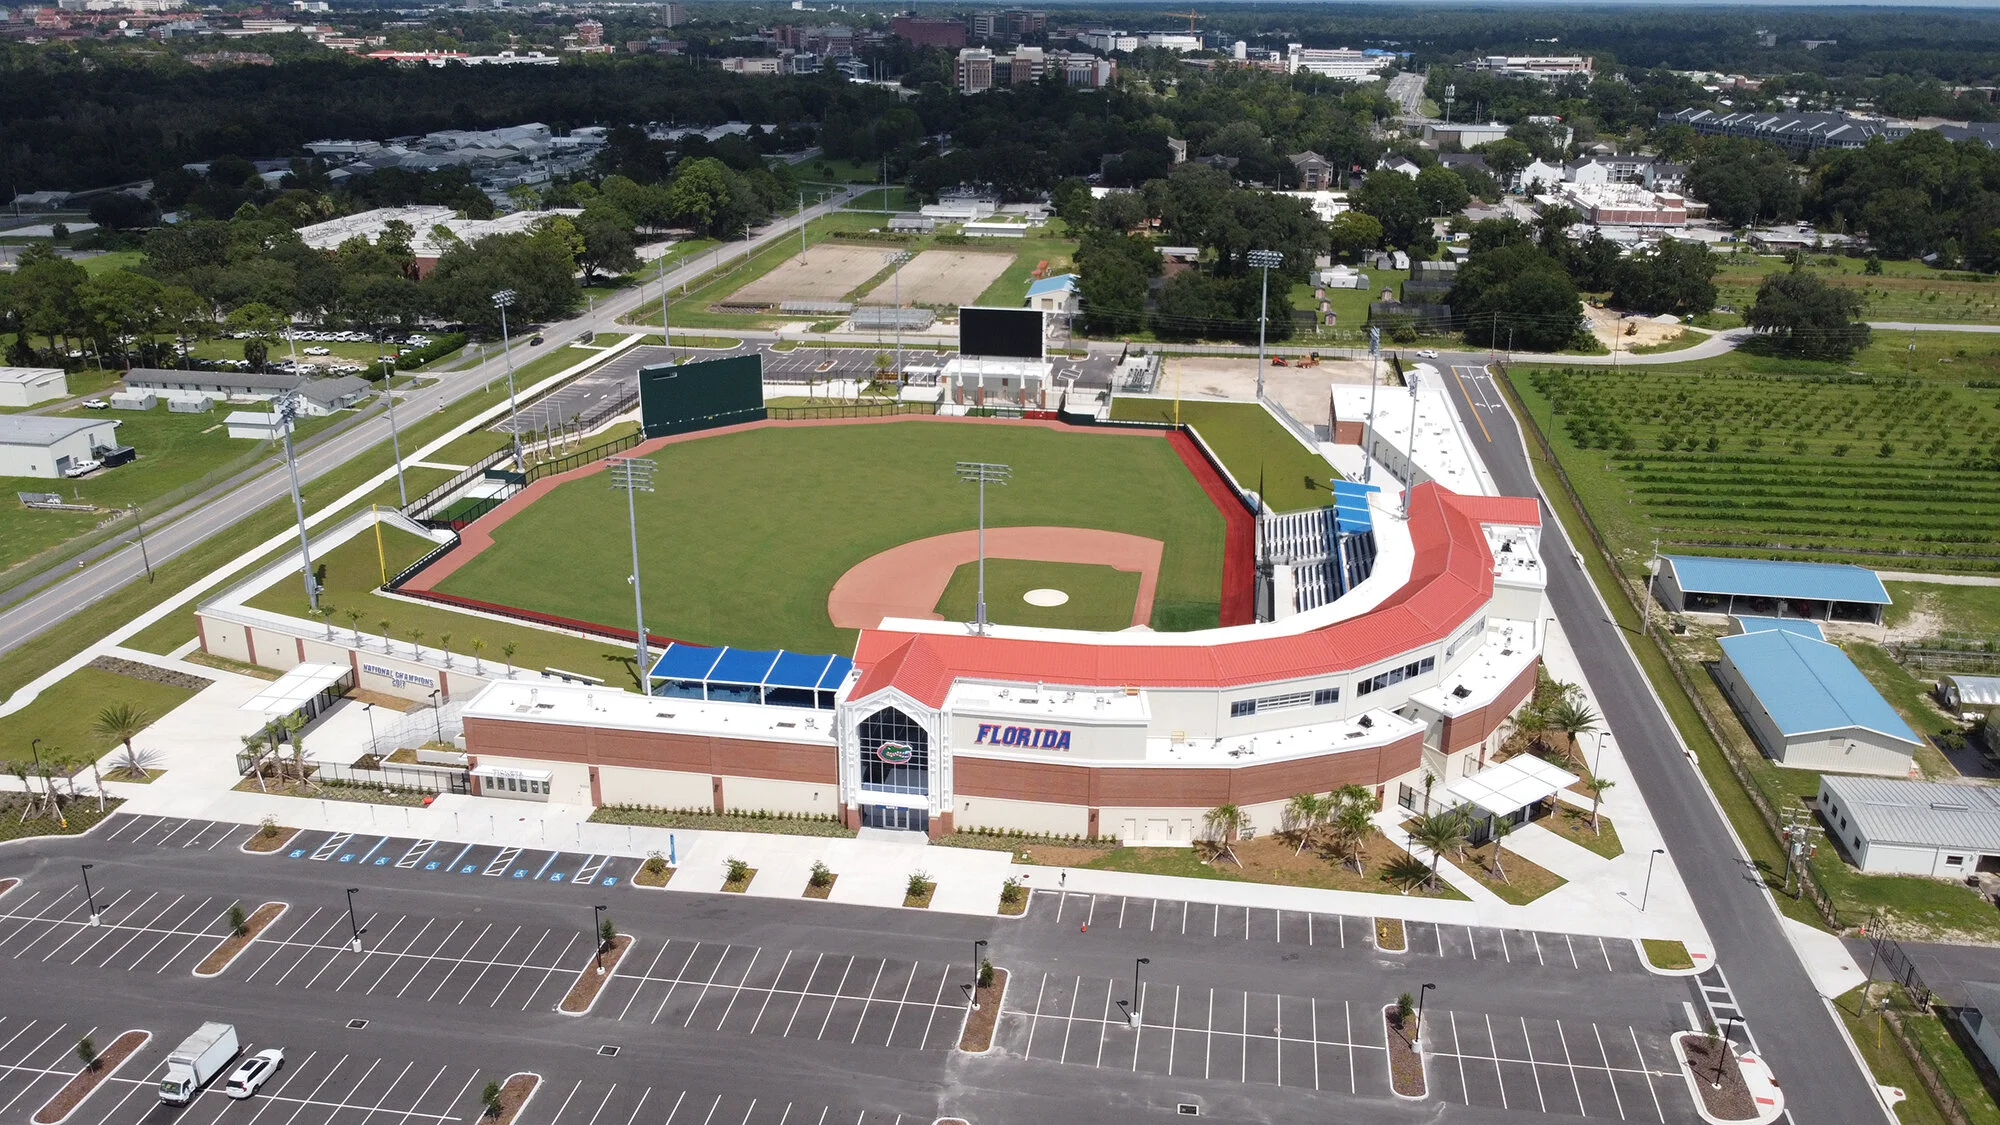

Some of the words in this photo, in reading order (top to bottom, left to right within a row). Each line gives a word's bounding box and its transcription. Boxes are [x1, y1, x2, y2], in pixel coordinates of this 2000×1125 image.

[363, 663, 393, 677] NATIONAL
[395, 671, 434, 686] CHAMPIONS
[976, 723, 1071, 749] FLORIDA
